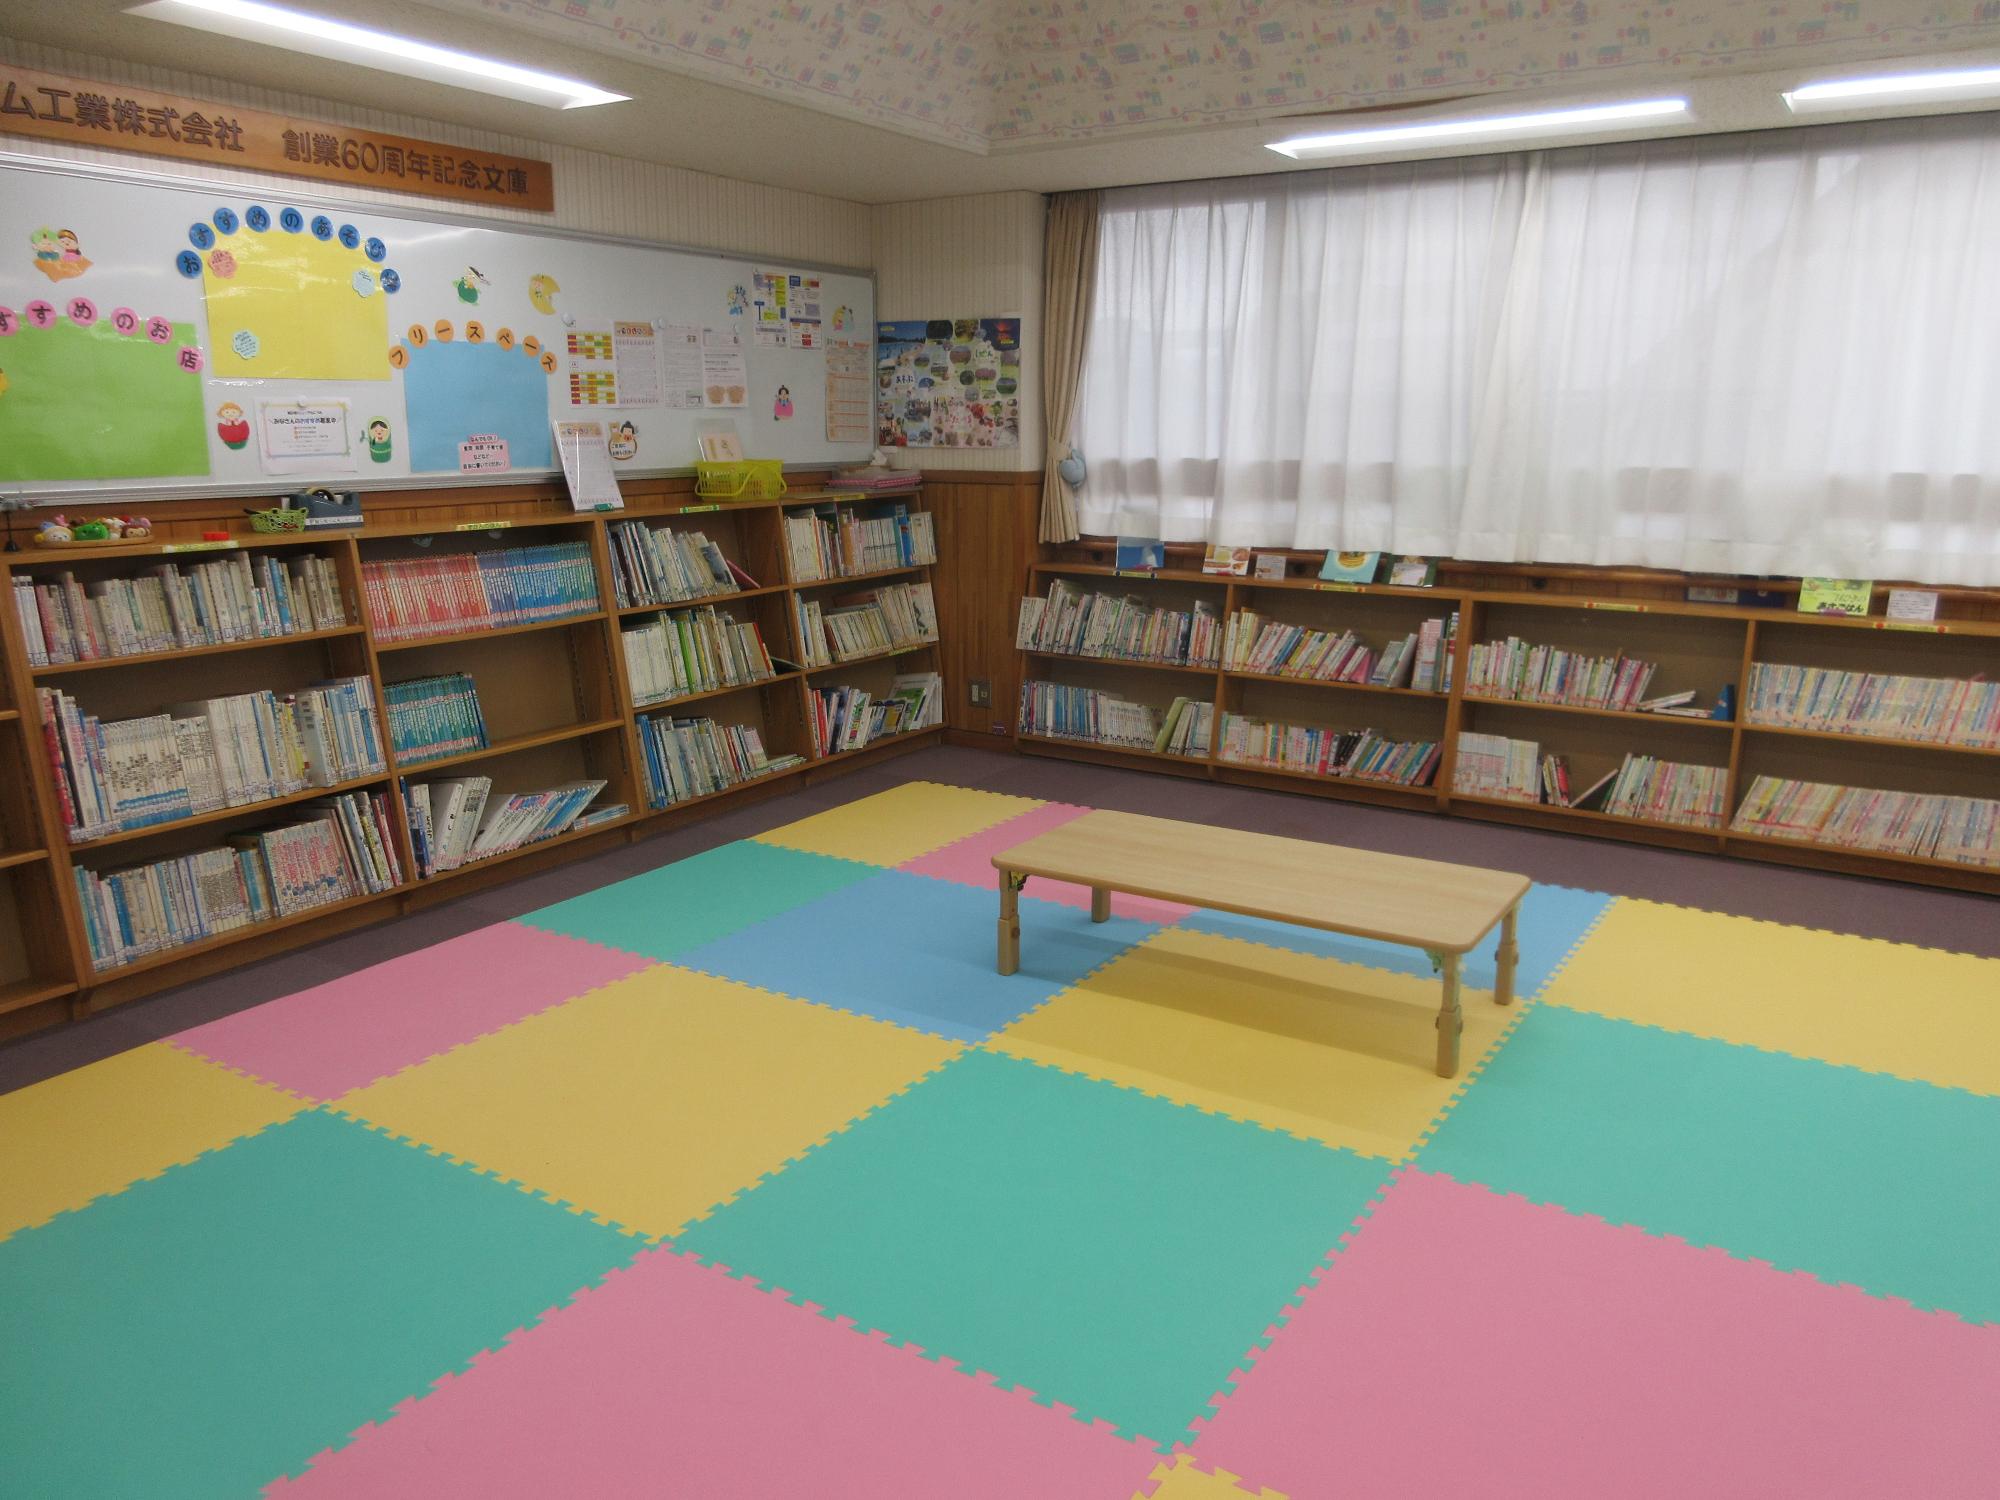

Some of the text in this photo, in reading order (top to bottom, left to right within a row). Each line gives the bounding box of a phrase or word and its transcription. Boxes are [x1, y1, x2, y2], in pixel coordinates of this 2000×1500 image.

[1, 82, 530, 196] ム工業株式会社 創業60周年記念文庫
[391, 326, 553, 371] フリースペース
